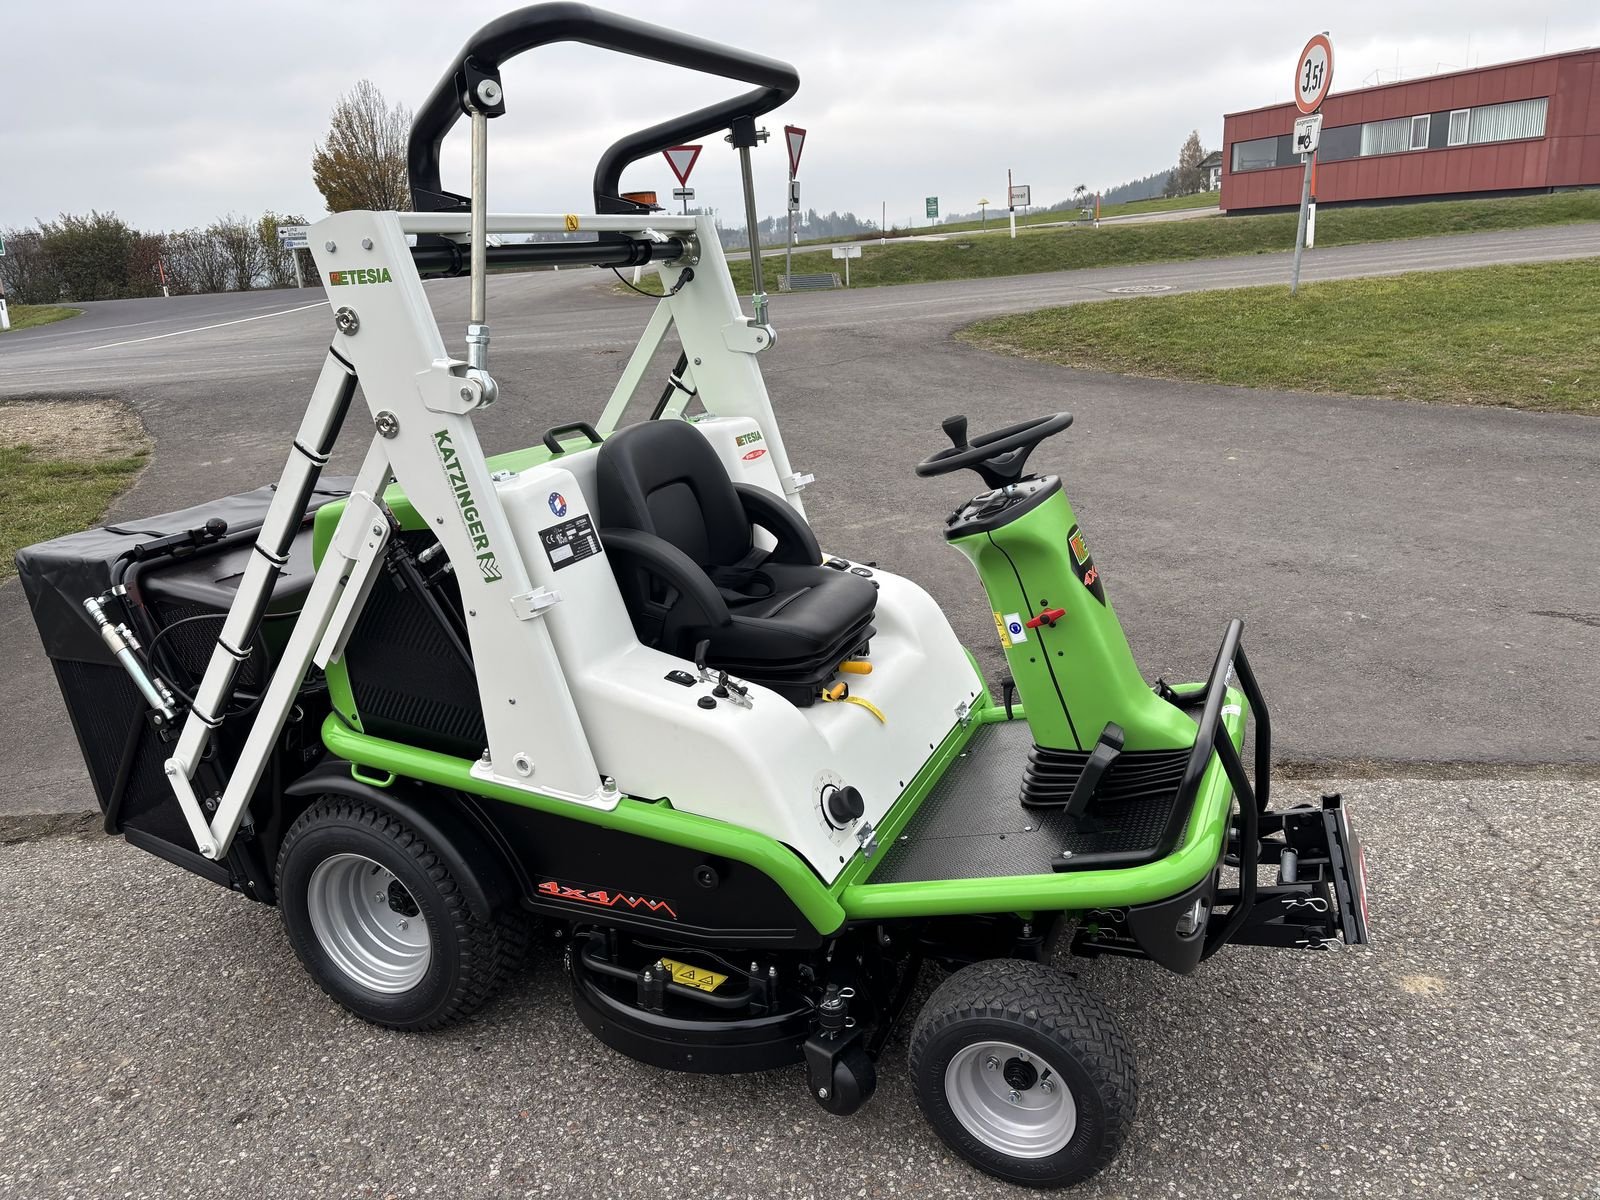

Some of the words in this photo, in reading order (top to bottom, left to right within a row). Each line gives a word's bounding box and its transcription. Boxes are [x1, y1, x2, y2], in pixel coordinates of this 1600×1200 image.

[329, 268, 392, 286] ETESIA
[735, 430, 763, 447] ETESIA
[434, 429, 490, 551] KATZINGER
